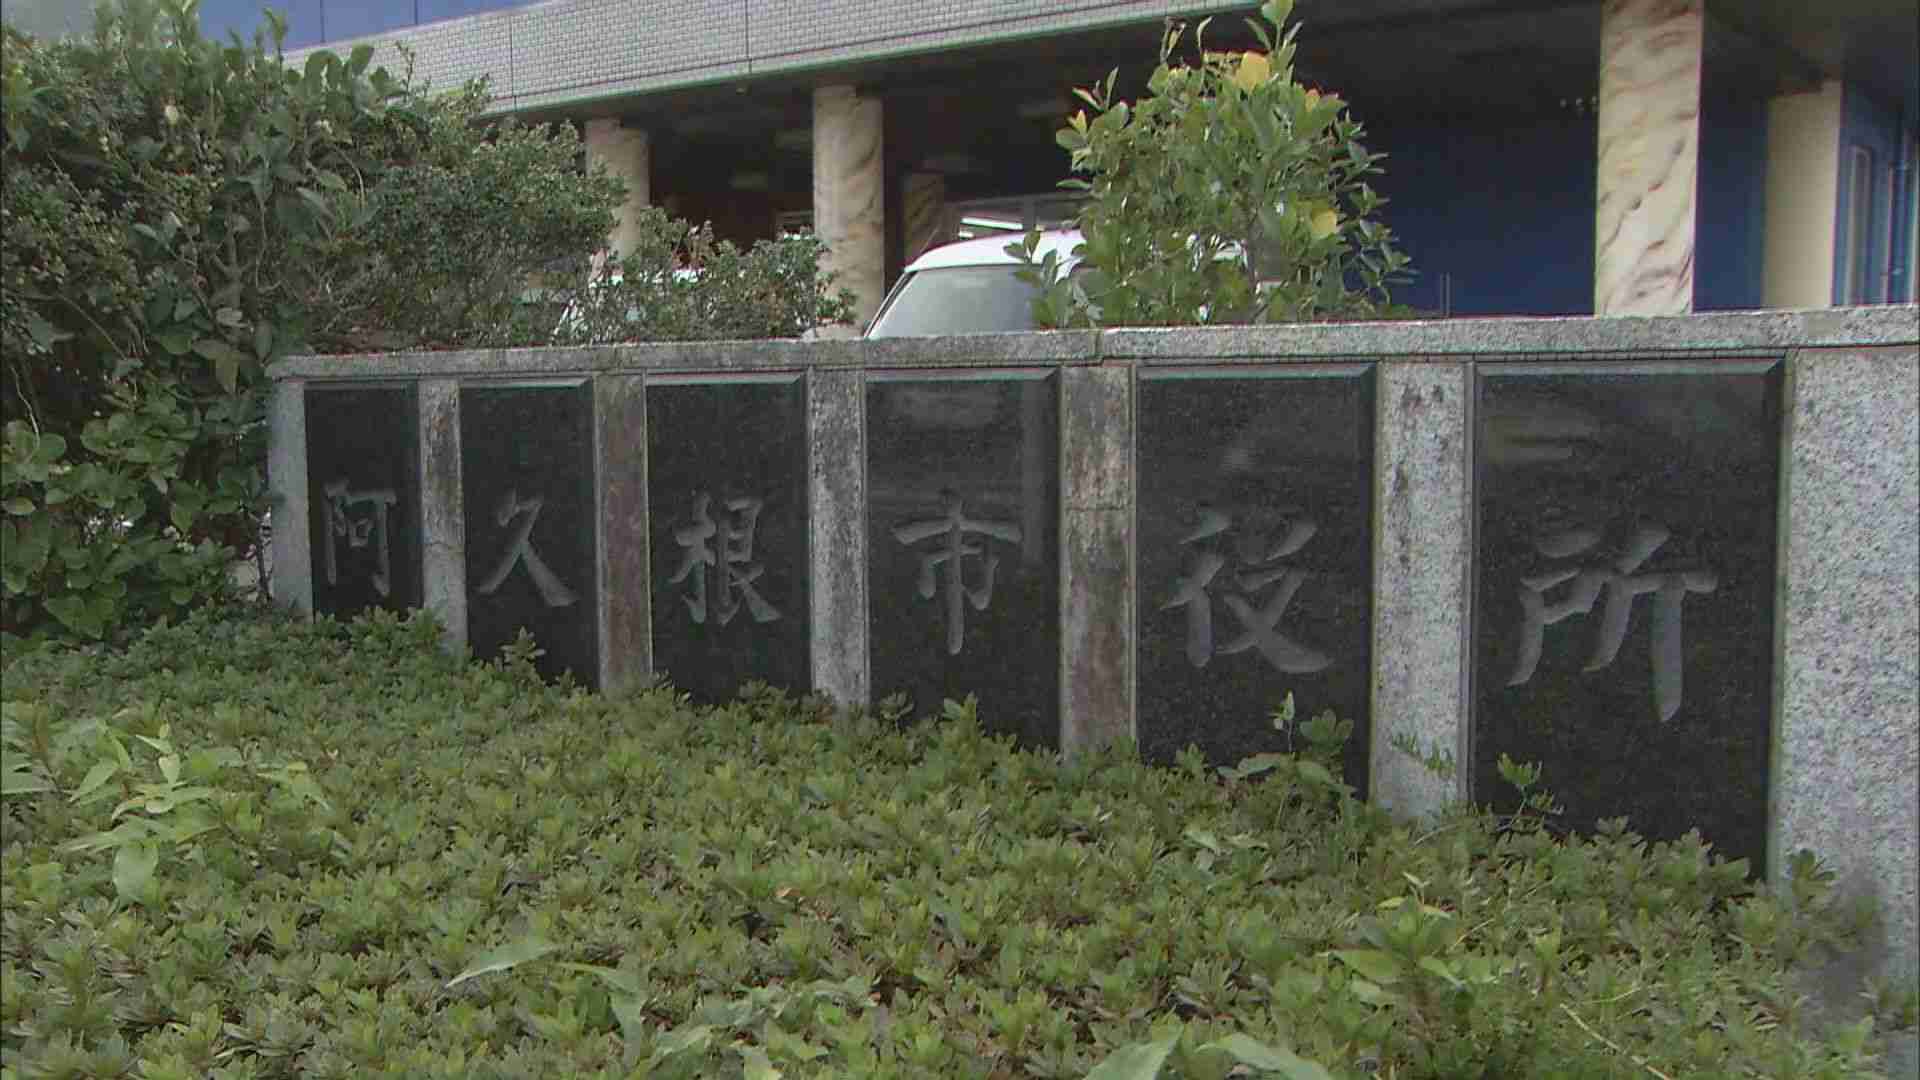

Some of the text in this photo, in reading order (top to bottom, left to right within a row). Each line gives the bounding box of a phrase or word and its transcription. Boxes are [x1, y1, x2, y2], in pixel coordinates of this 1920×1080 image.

[322, 481, 1719, 722] 阿久根市役所
